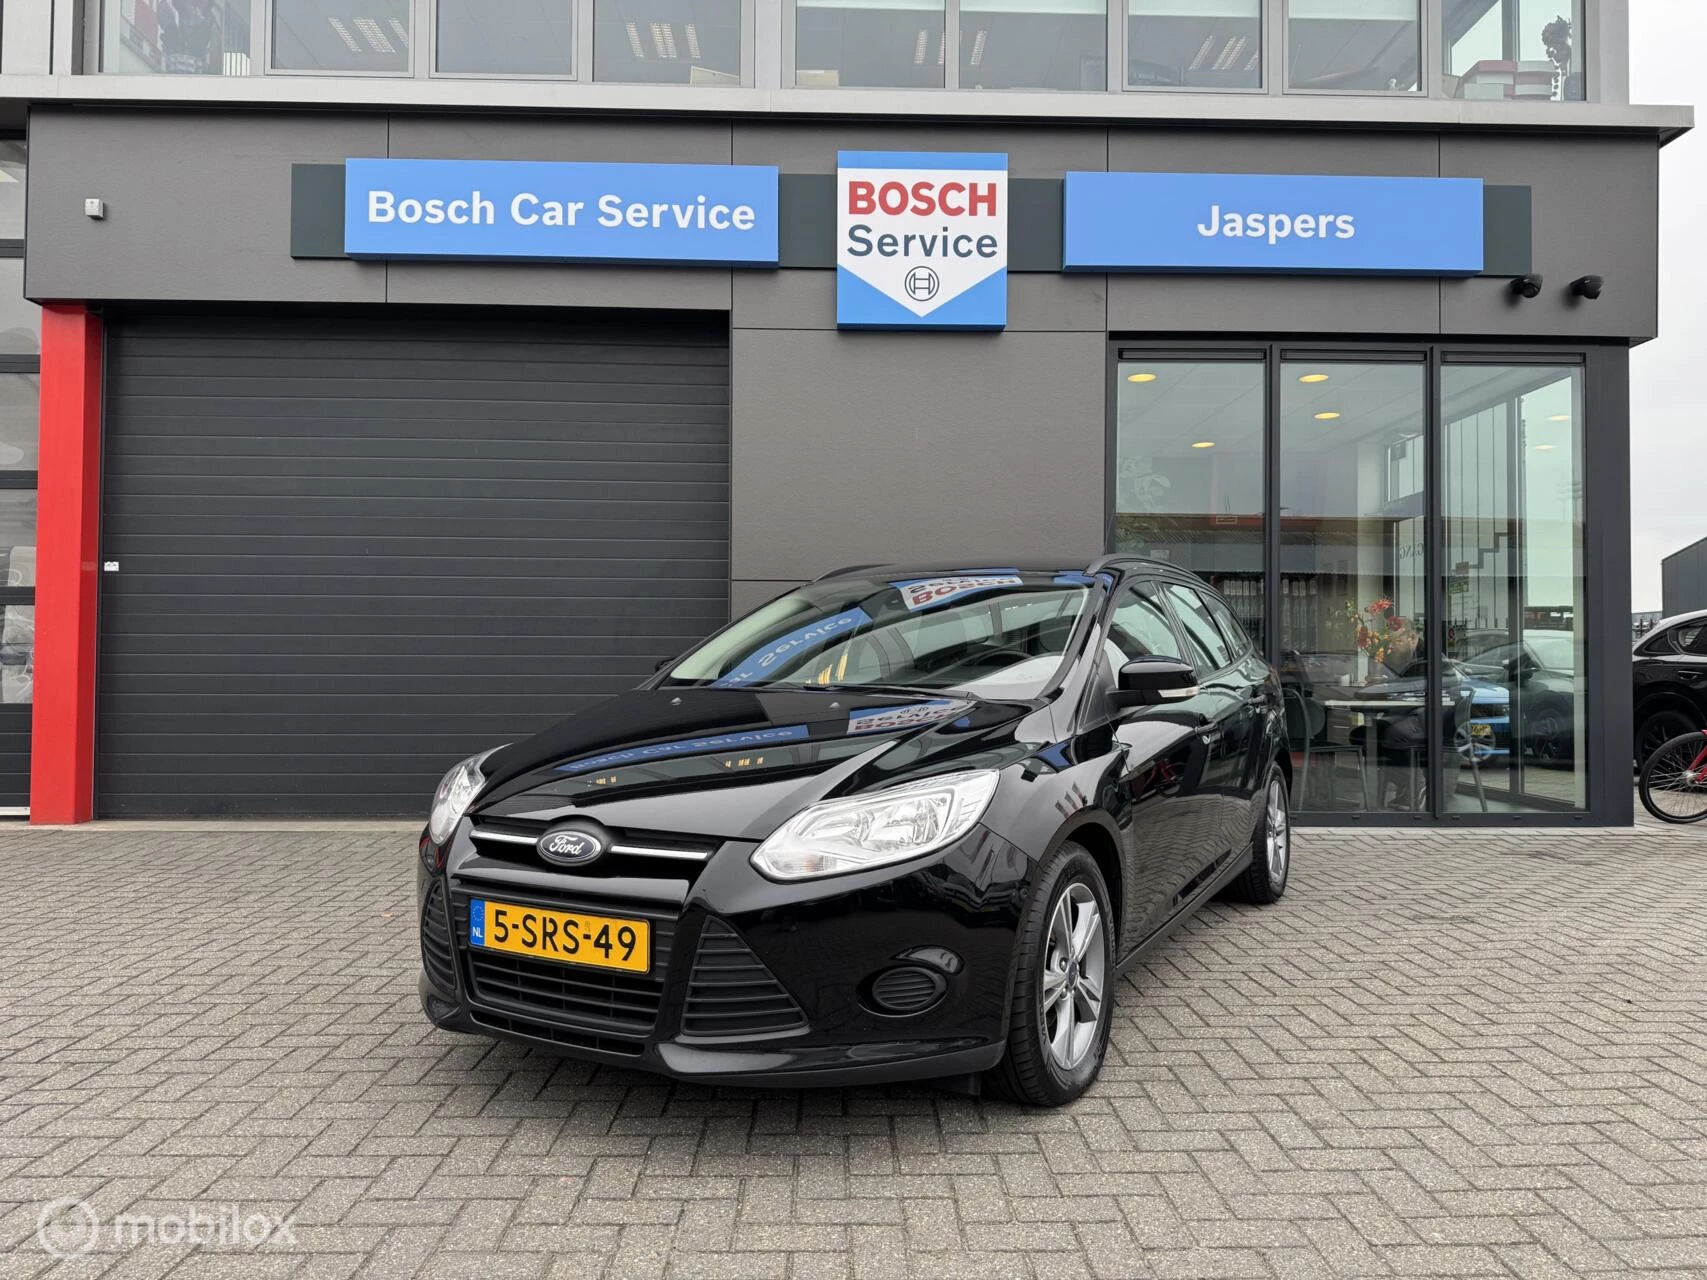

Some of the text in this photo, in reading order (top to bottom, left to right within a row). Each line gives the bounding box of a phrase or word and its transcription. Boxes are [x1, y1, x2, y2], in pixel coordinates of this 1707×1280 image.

[367, 190, 756, 231] Bosch Car Service
[848, 180, 997, 217] BOSCH
[847, 224, 998, 259] Service
[1197, 204, 1355, 245] Jaspers
[548, 834, 585, 855] Ford
[472, 926, 484, 938] NL
[494, 908, 637, 962] 5-SRS-49
